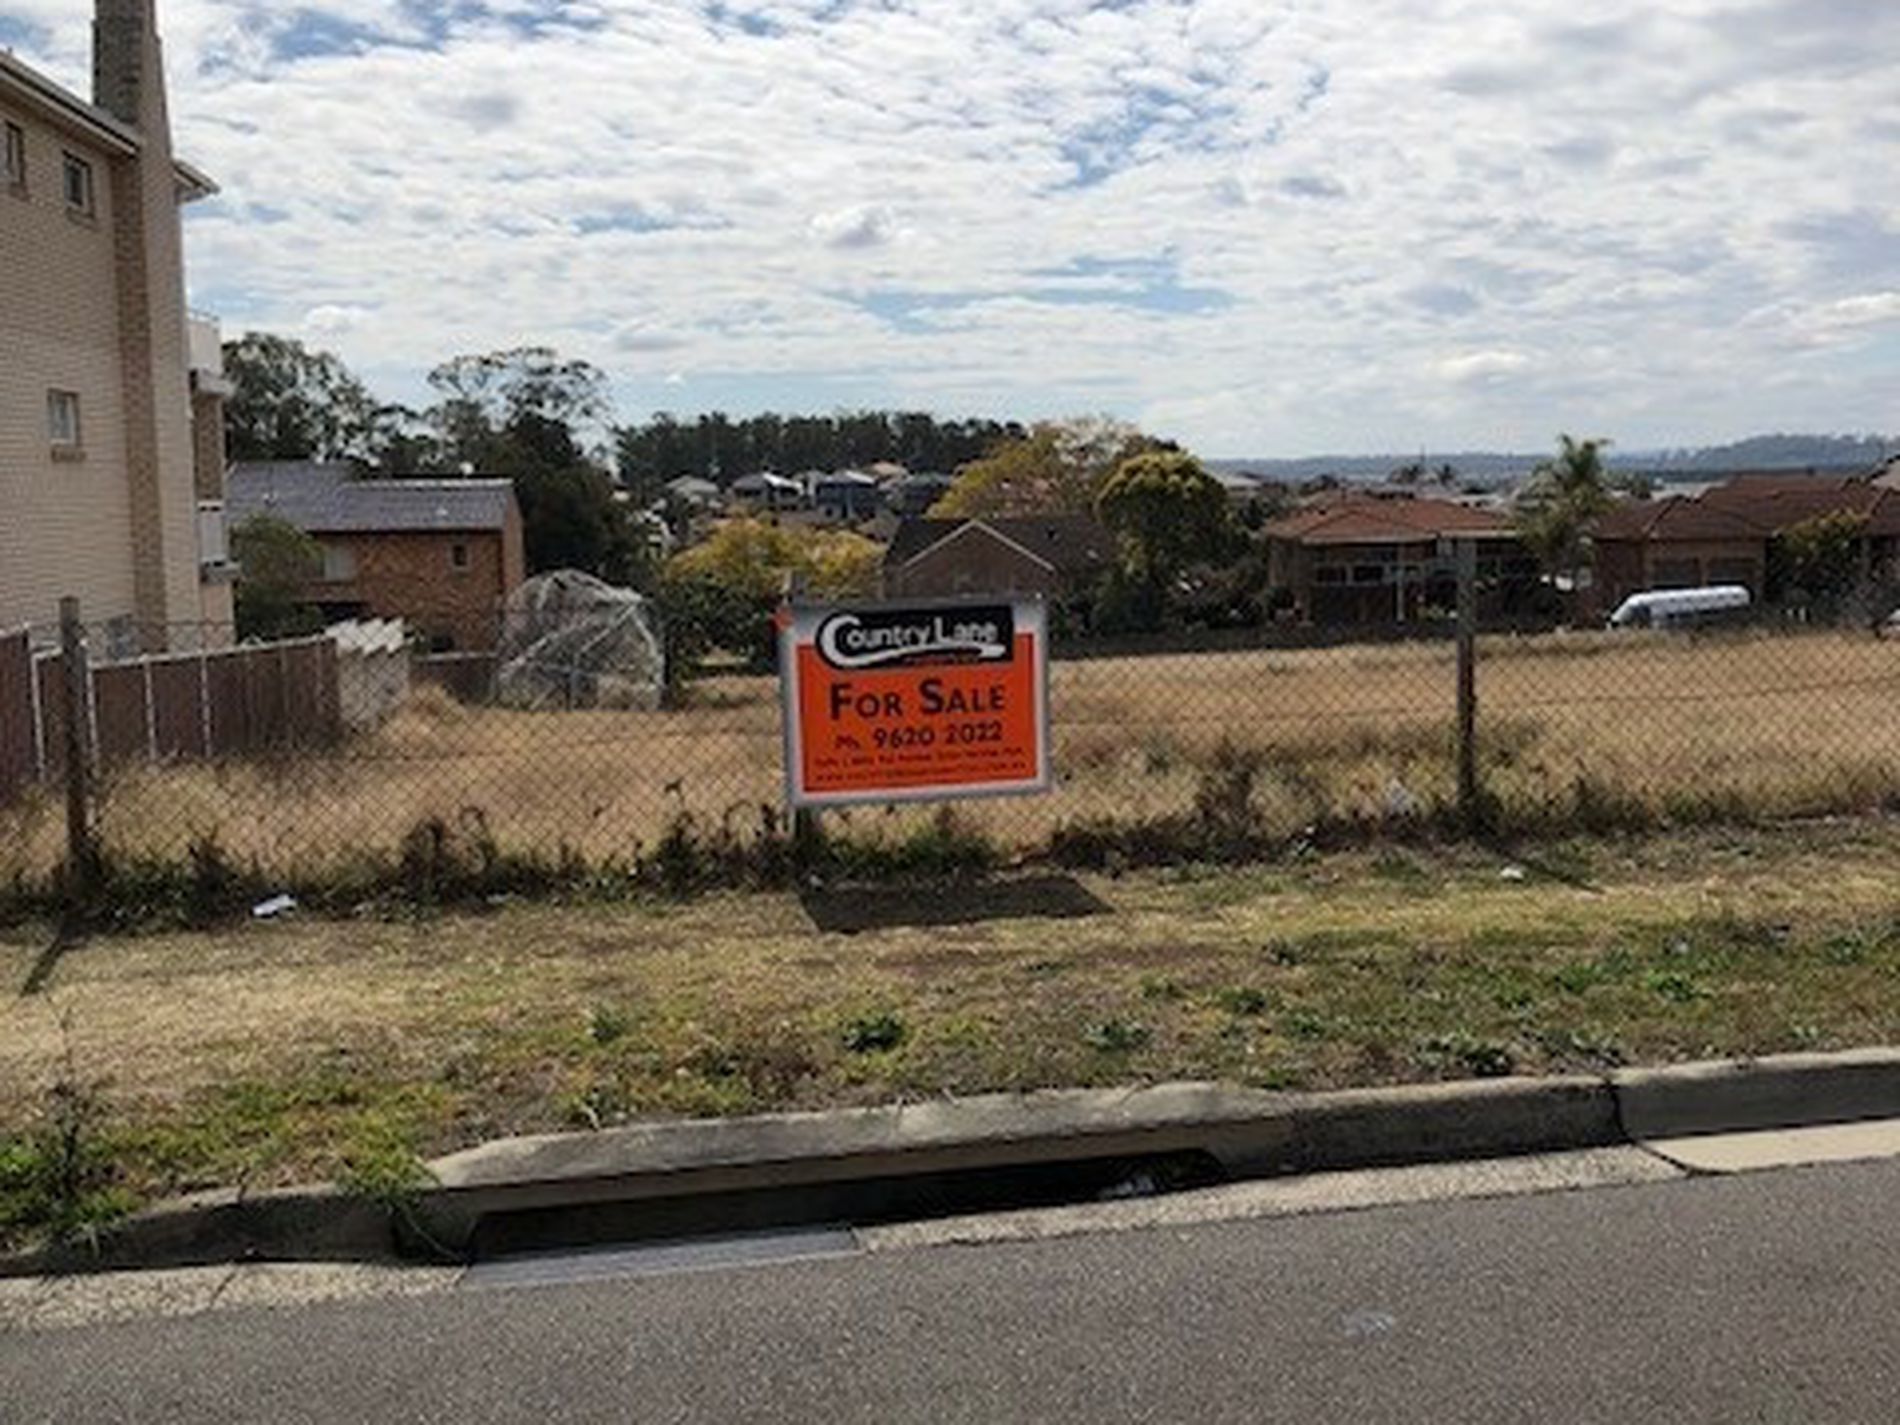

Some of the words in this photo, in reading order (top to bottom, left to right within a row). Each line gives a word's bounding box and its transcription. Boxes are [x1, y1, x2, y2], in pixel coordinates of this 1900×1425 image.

[820, 615, 931, 666] Country
[934, 617, 998, 645] Lane
[829, 683, 904, 720] FOR
[919, 678, 1006, 715] SALE
[873, 727, 935, 749] 9620
[946, 720, 1003, 744] 2022
